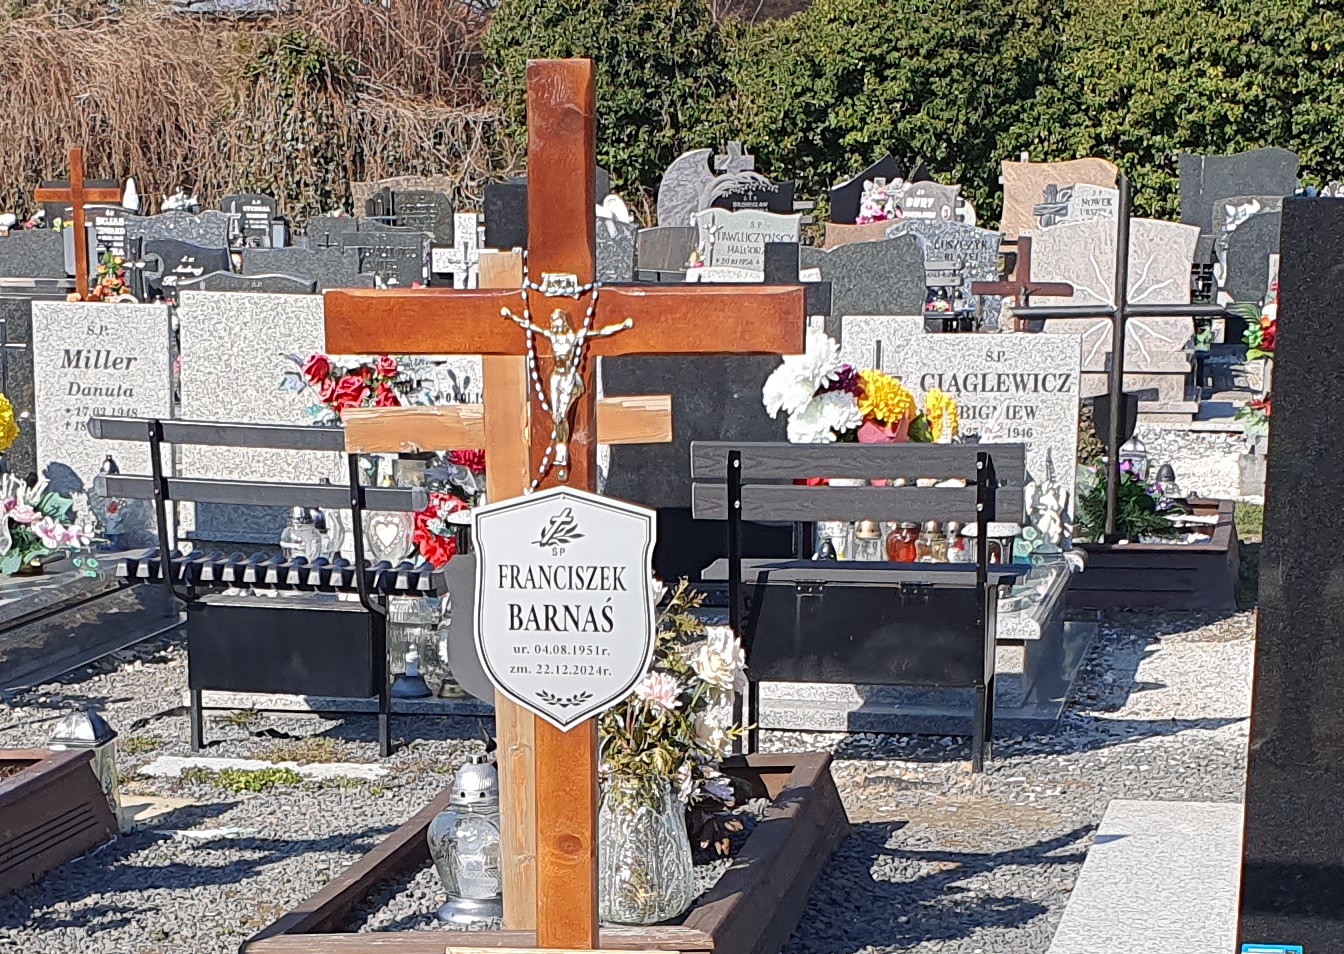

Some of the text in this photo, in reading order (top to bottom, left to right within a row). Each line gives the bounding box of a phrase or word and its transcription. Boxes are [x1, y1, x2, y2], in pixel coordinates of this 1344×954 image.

[60, 348, 138, 371] Miller
[66, 381, 135, 398] Danuta
[919, 372, 1073, 397] CIĄGLEWICZ
[497, 564, 628, 592] FRANCISZEK
[507, 597, 615, 633] BARNAŚ
[513, 645, 611, 657] ur. 04.08.1951r.
[509, 664, 613, 677] zm. 22.12.2024r.
